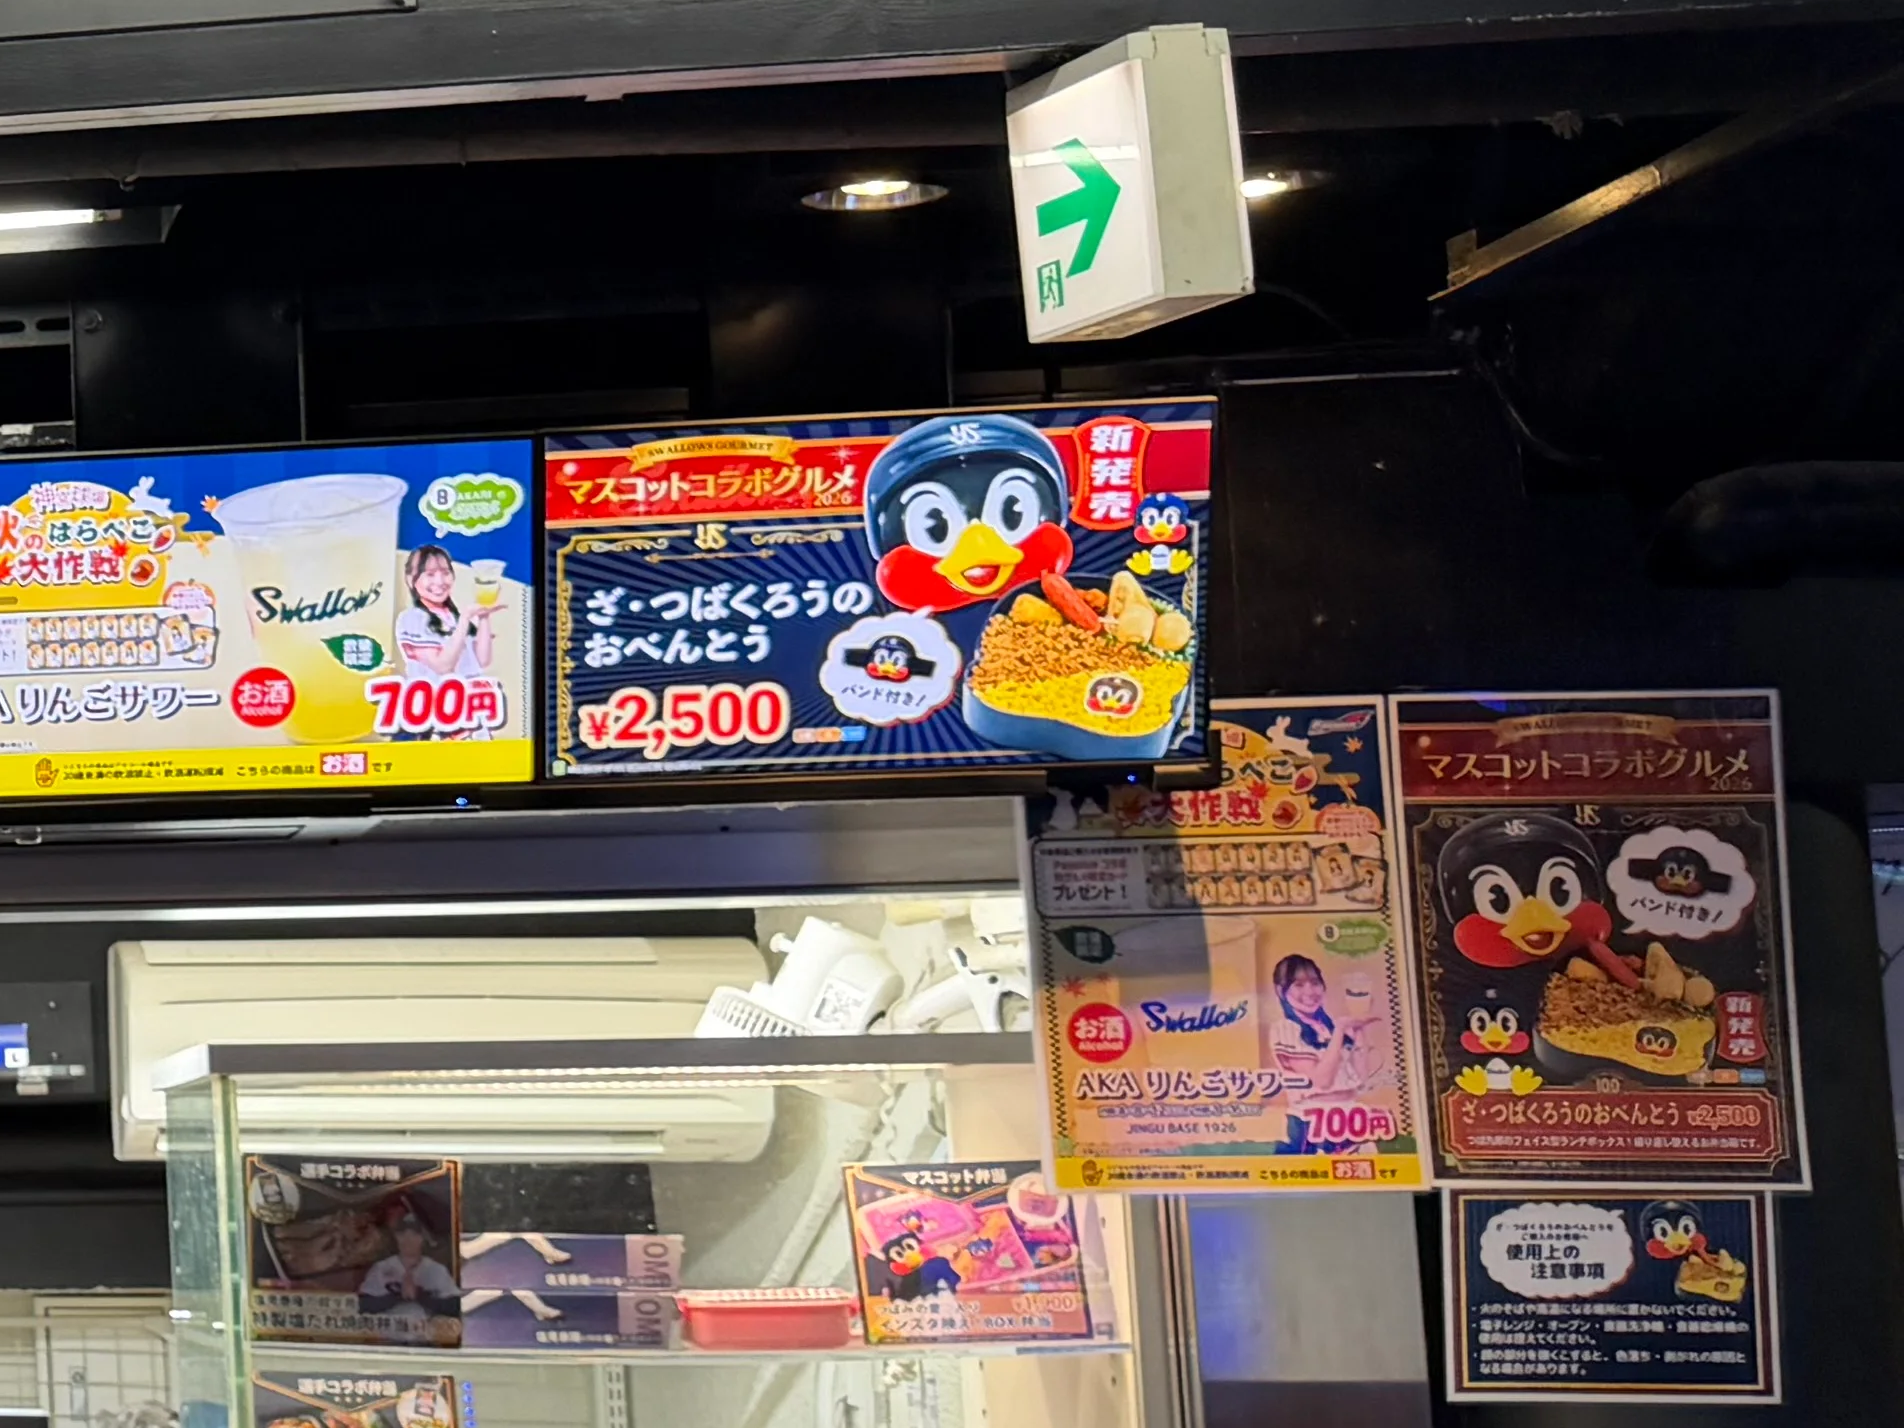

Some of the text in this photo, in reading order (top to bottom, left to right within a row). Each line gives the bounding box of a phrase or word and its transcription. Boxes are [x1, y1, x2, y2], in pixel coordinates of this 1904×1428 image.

[647, 438, 773, 459] SWALLOWS GOURMET
[567, 465, 854, 506] マスコットコラボグルメ
[1089, 425, 1132, 520] 新発売
[813, 489, 853, 506] 2026
[18, 551, 121, 583] 大作戦
[252, 582, 382, 624] Swallows
[585, 578, 874, 625] ざ・つばくろうの
[585, 625, 771, 666] おべんとう
[18, 683, 220, 723] りんごサワー
[239, 680, 289, 706] お酒
[370, 679, 497, 727] 700円
[581, 683, 789, 758] ¥2,500
[322, 755, 365, 774] お酒
[371, 762, 393, 774] です
[1422, 749, 1749, 780] マスコットコラボグルメ
[1709, 777, 1753, 790] 2026
[1156, 790, 1261, 824] 大作戦
[1053, 886, 1127, 901] プレゼント！
[1074, 1016, 1125, 1040] お酒
[1142, 1001, 1247, 1032] Swallows
[1726, 997, 1759, 1056] 新発売
[1075, 1070, 1312, 1096] AKA りんごサワー
[1596, 1078, 1620, 1094] 100
[1305, 1109, 1391, 1138] 700円
[1462, 1102, 1680, 1127] ざ・つばくろうのおべんとう
[1127, 1123, 1236, 1134] JINGU BASE 1926
[903, 1170, 1007, 1185] マスコット弁当
[1333, 1162, 1374, 1179] お酒
[1377, 1169, 1397, 1179] です
[1507, 1245, 1580, 1260] 使用上の
[1531, 1263, 1604, 1279] 注意事項
